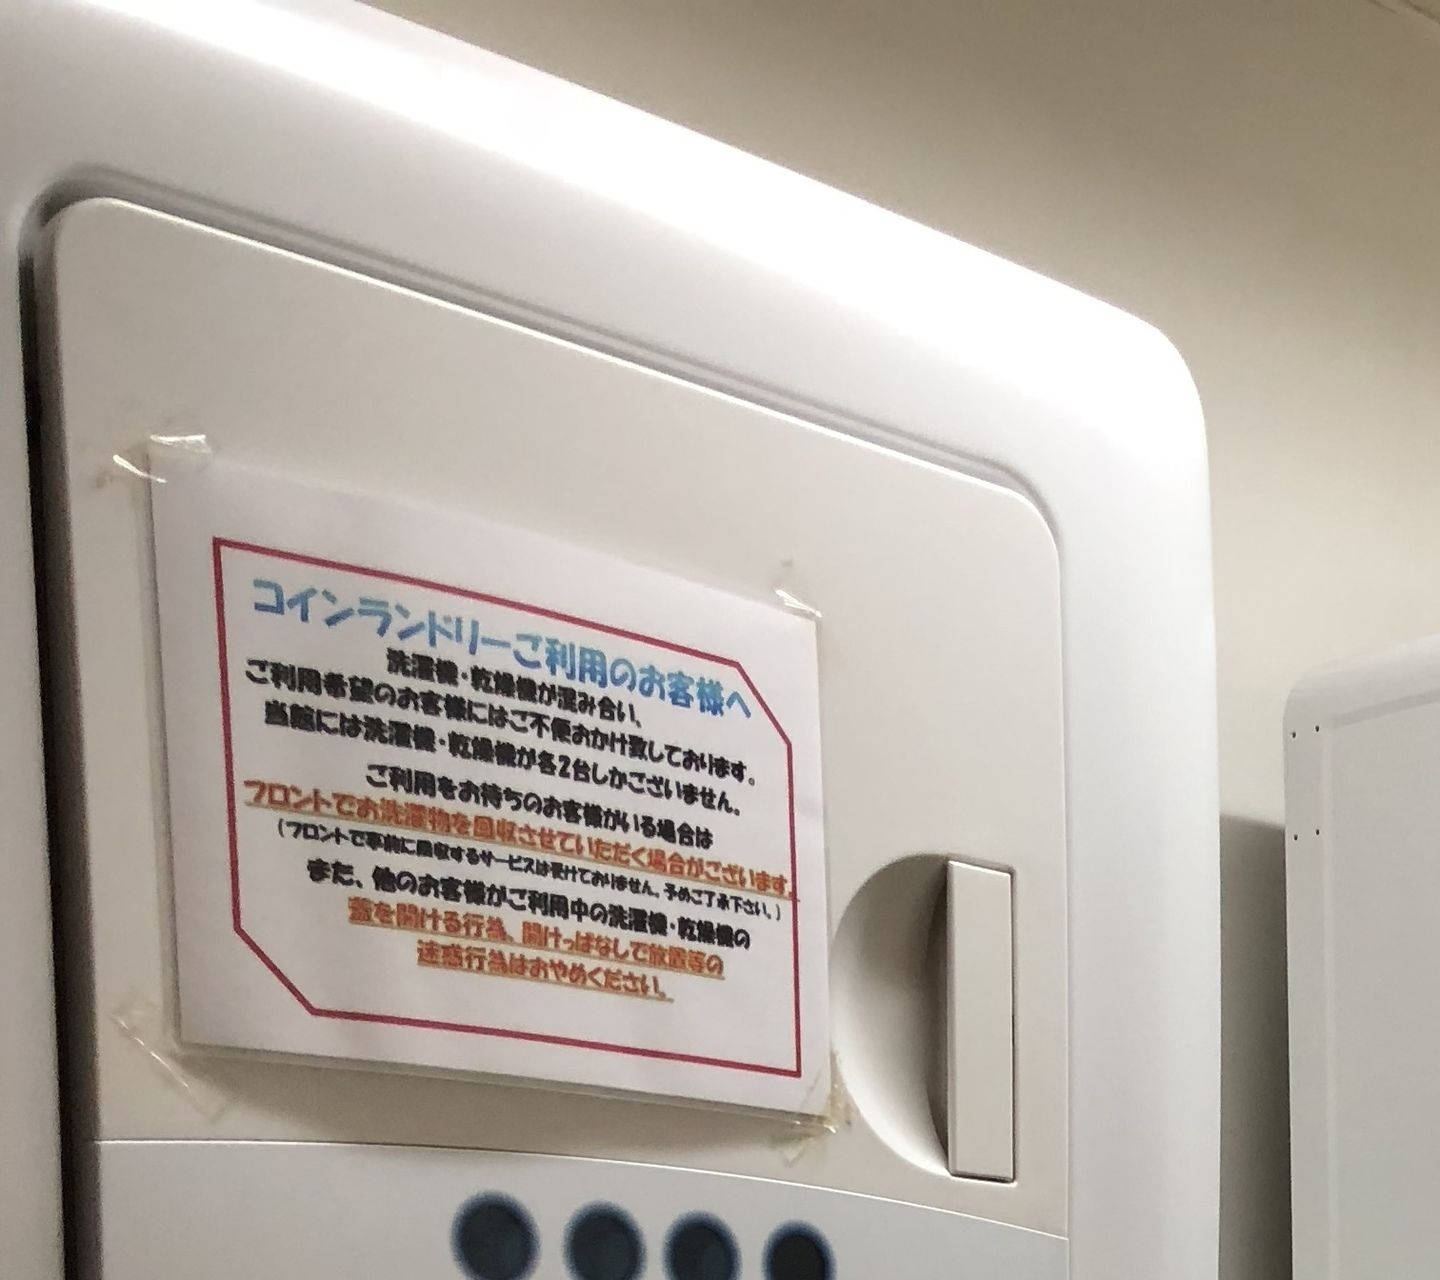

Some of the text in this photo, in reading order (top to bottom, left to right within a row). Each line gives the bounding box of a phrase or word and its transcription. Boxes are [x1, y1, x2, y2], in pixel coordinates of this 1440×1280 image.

[253, 579, 751, 718] コインランドリーご利用のお客様へ
